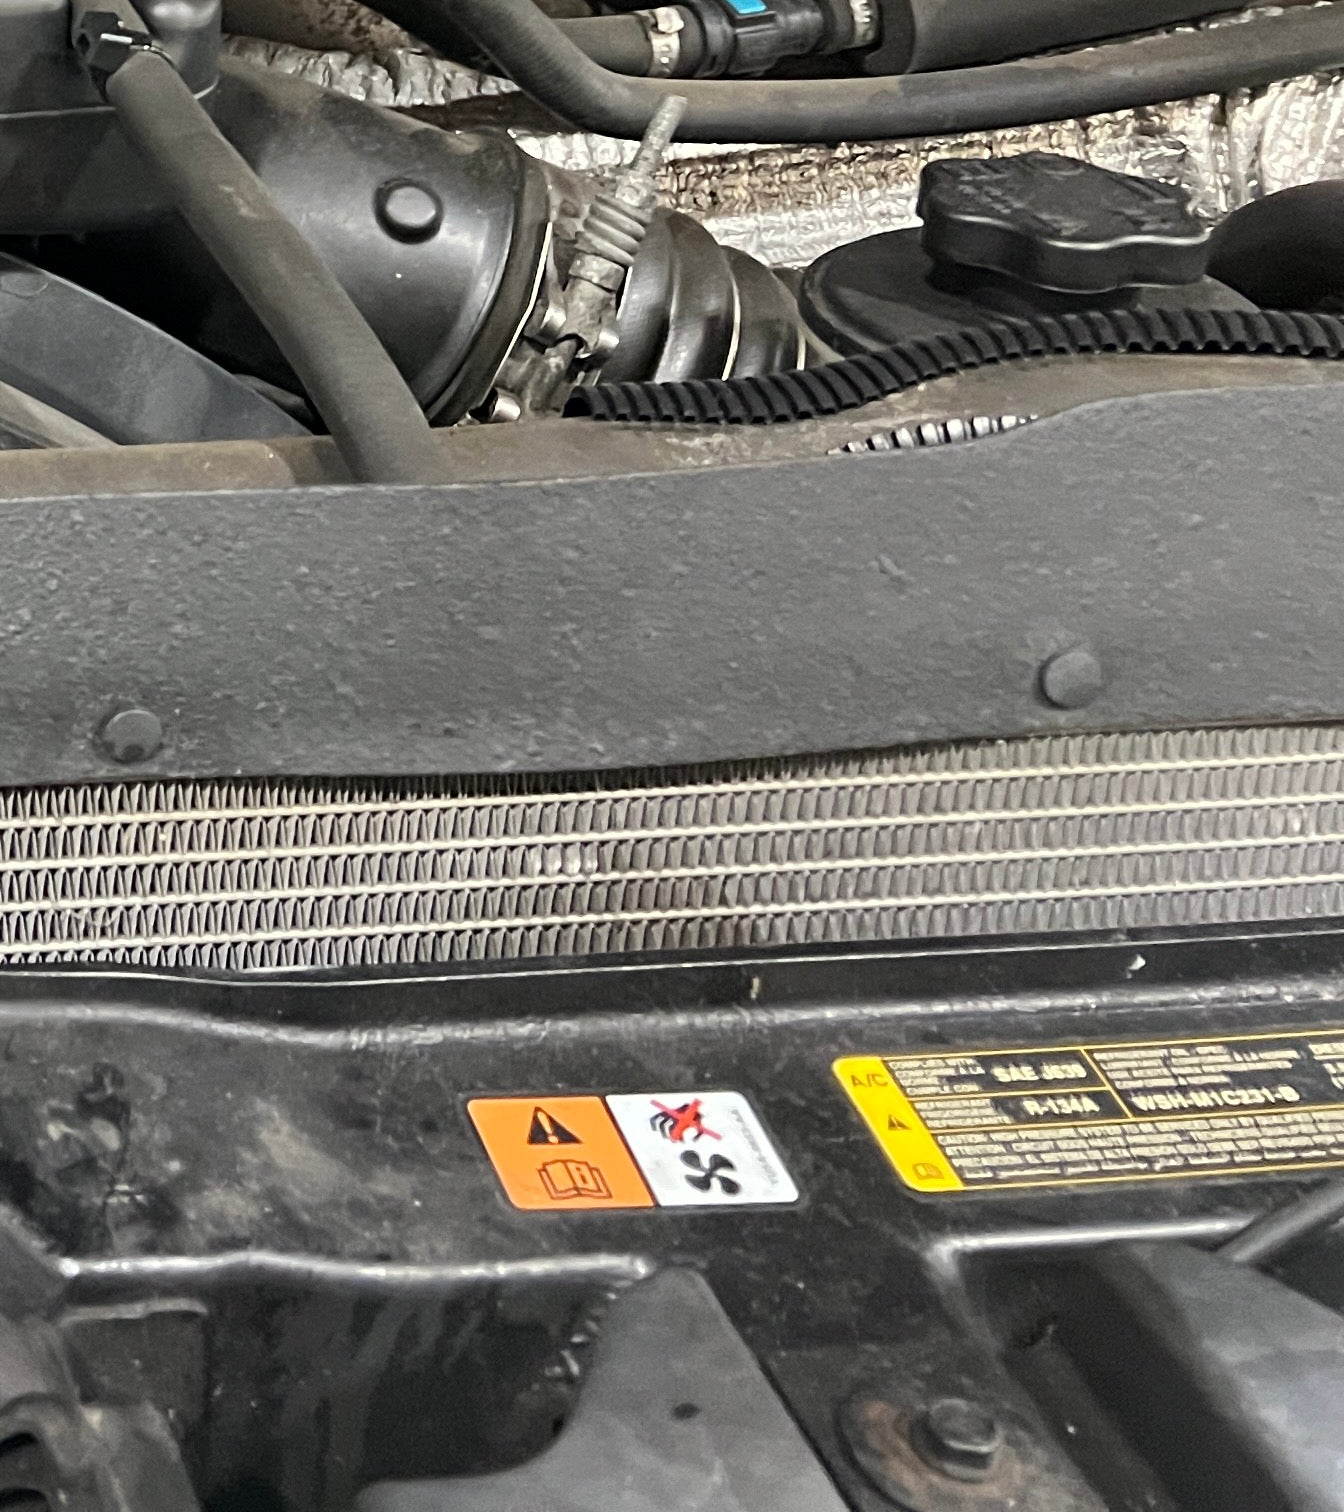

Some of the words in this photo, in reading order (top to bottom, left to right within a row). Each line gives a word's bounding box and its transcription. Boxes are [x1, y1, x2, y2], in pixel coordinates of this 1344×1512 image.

[849, 1074, 887, 1087] A/C
[990, 1064, 1038, 1082] SAE
[1020, 1096, 1100, 1115] R-134A
